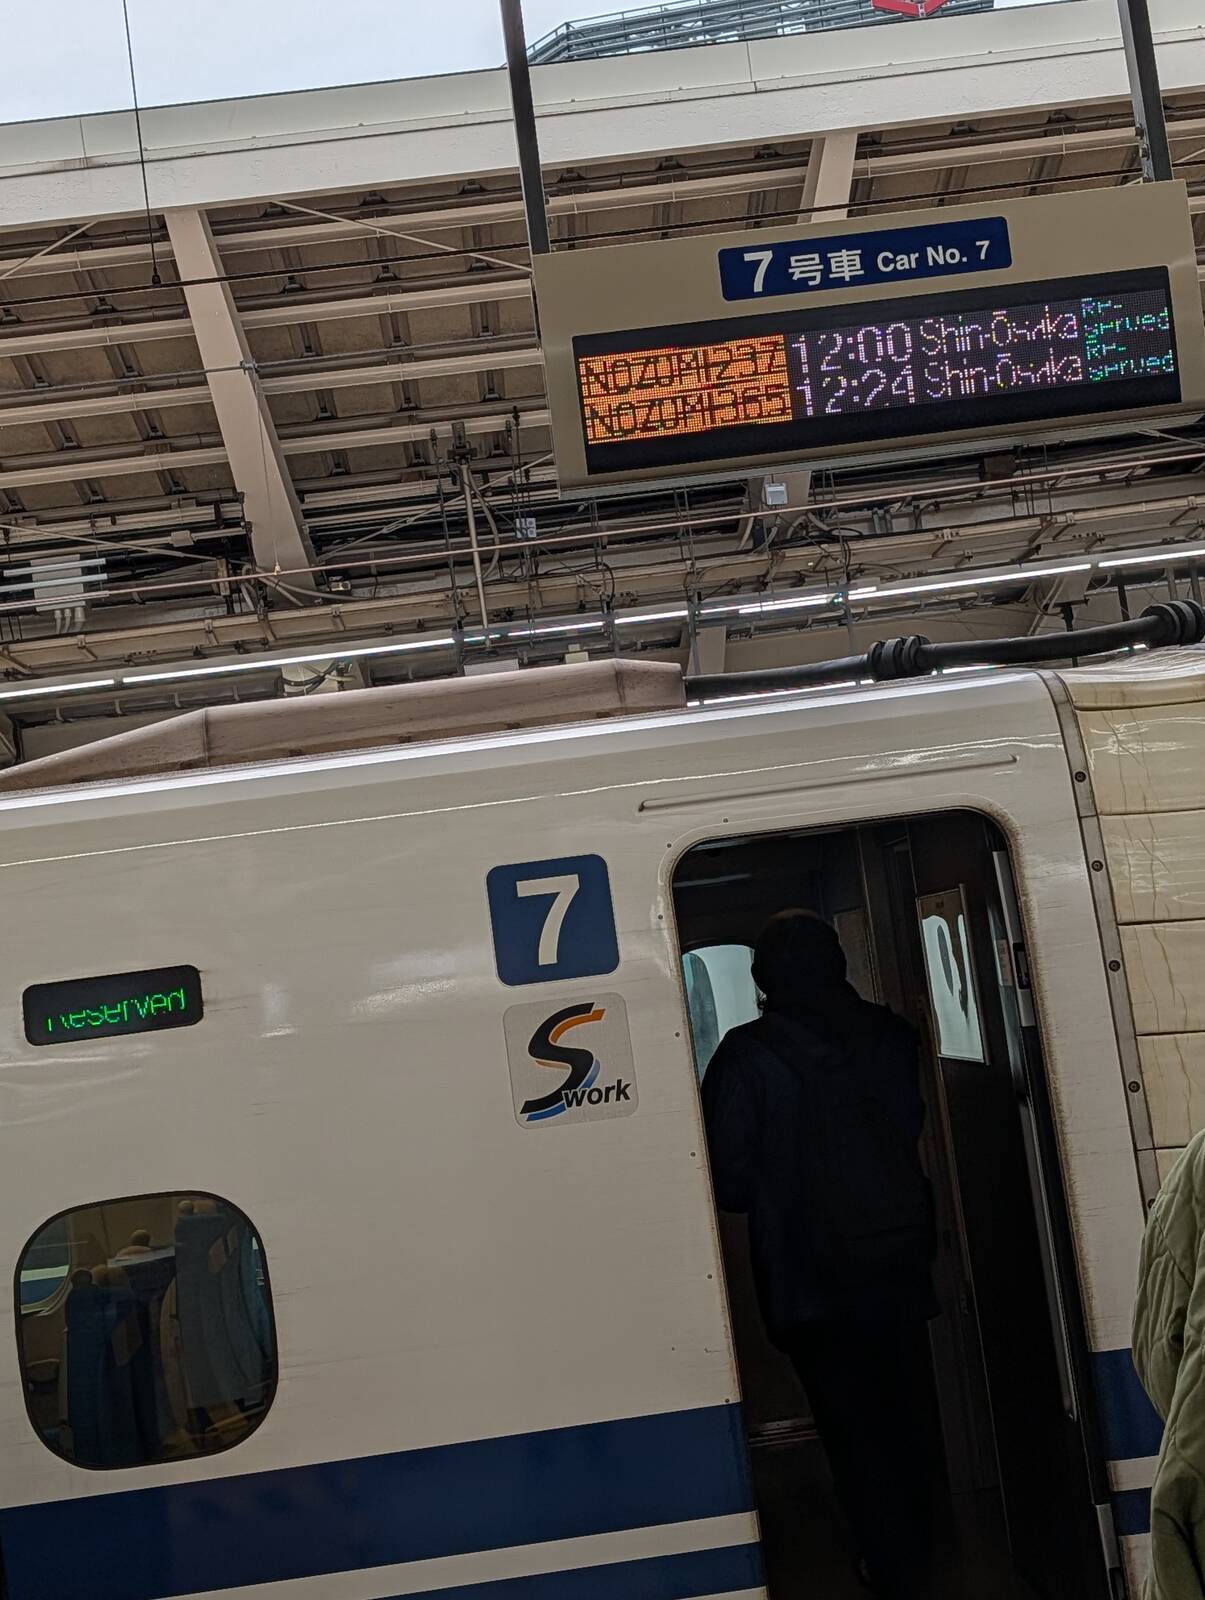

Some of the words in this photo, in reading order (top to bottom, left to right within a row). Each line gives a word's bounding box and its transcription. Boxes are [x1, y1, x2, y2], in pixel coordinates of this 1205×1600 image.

[742, 250, 773, 293] 7
[876, 251, 919, 273] Car
[927, 245, 968, 266] No.
[975, 239, 991, 261] 7
[792, 322, 912, 374] 12:00
[796, 365, 916, 416] 12:24
[516, 873, 580, 967] 7
[519, 1002, 606, 1122] S
[562, 1079, 632, 1108] work
